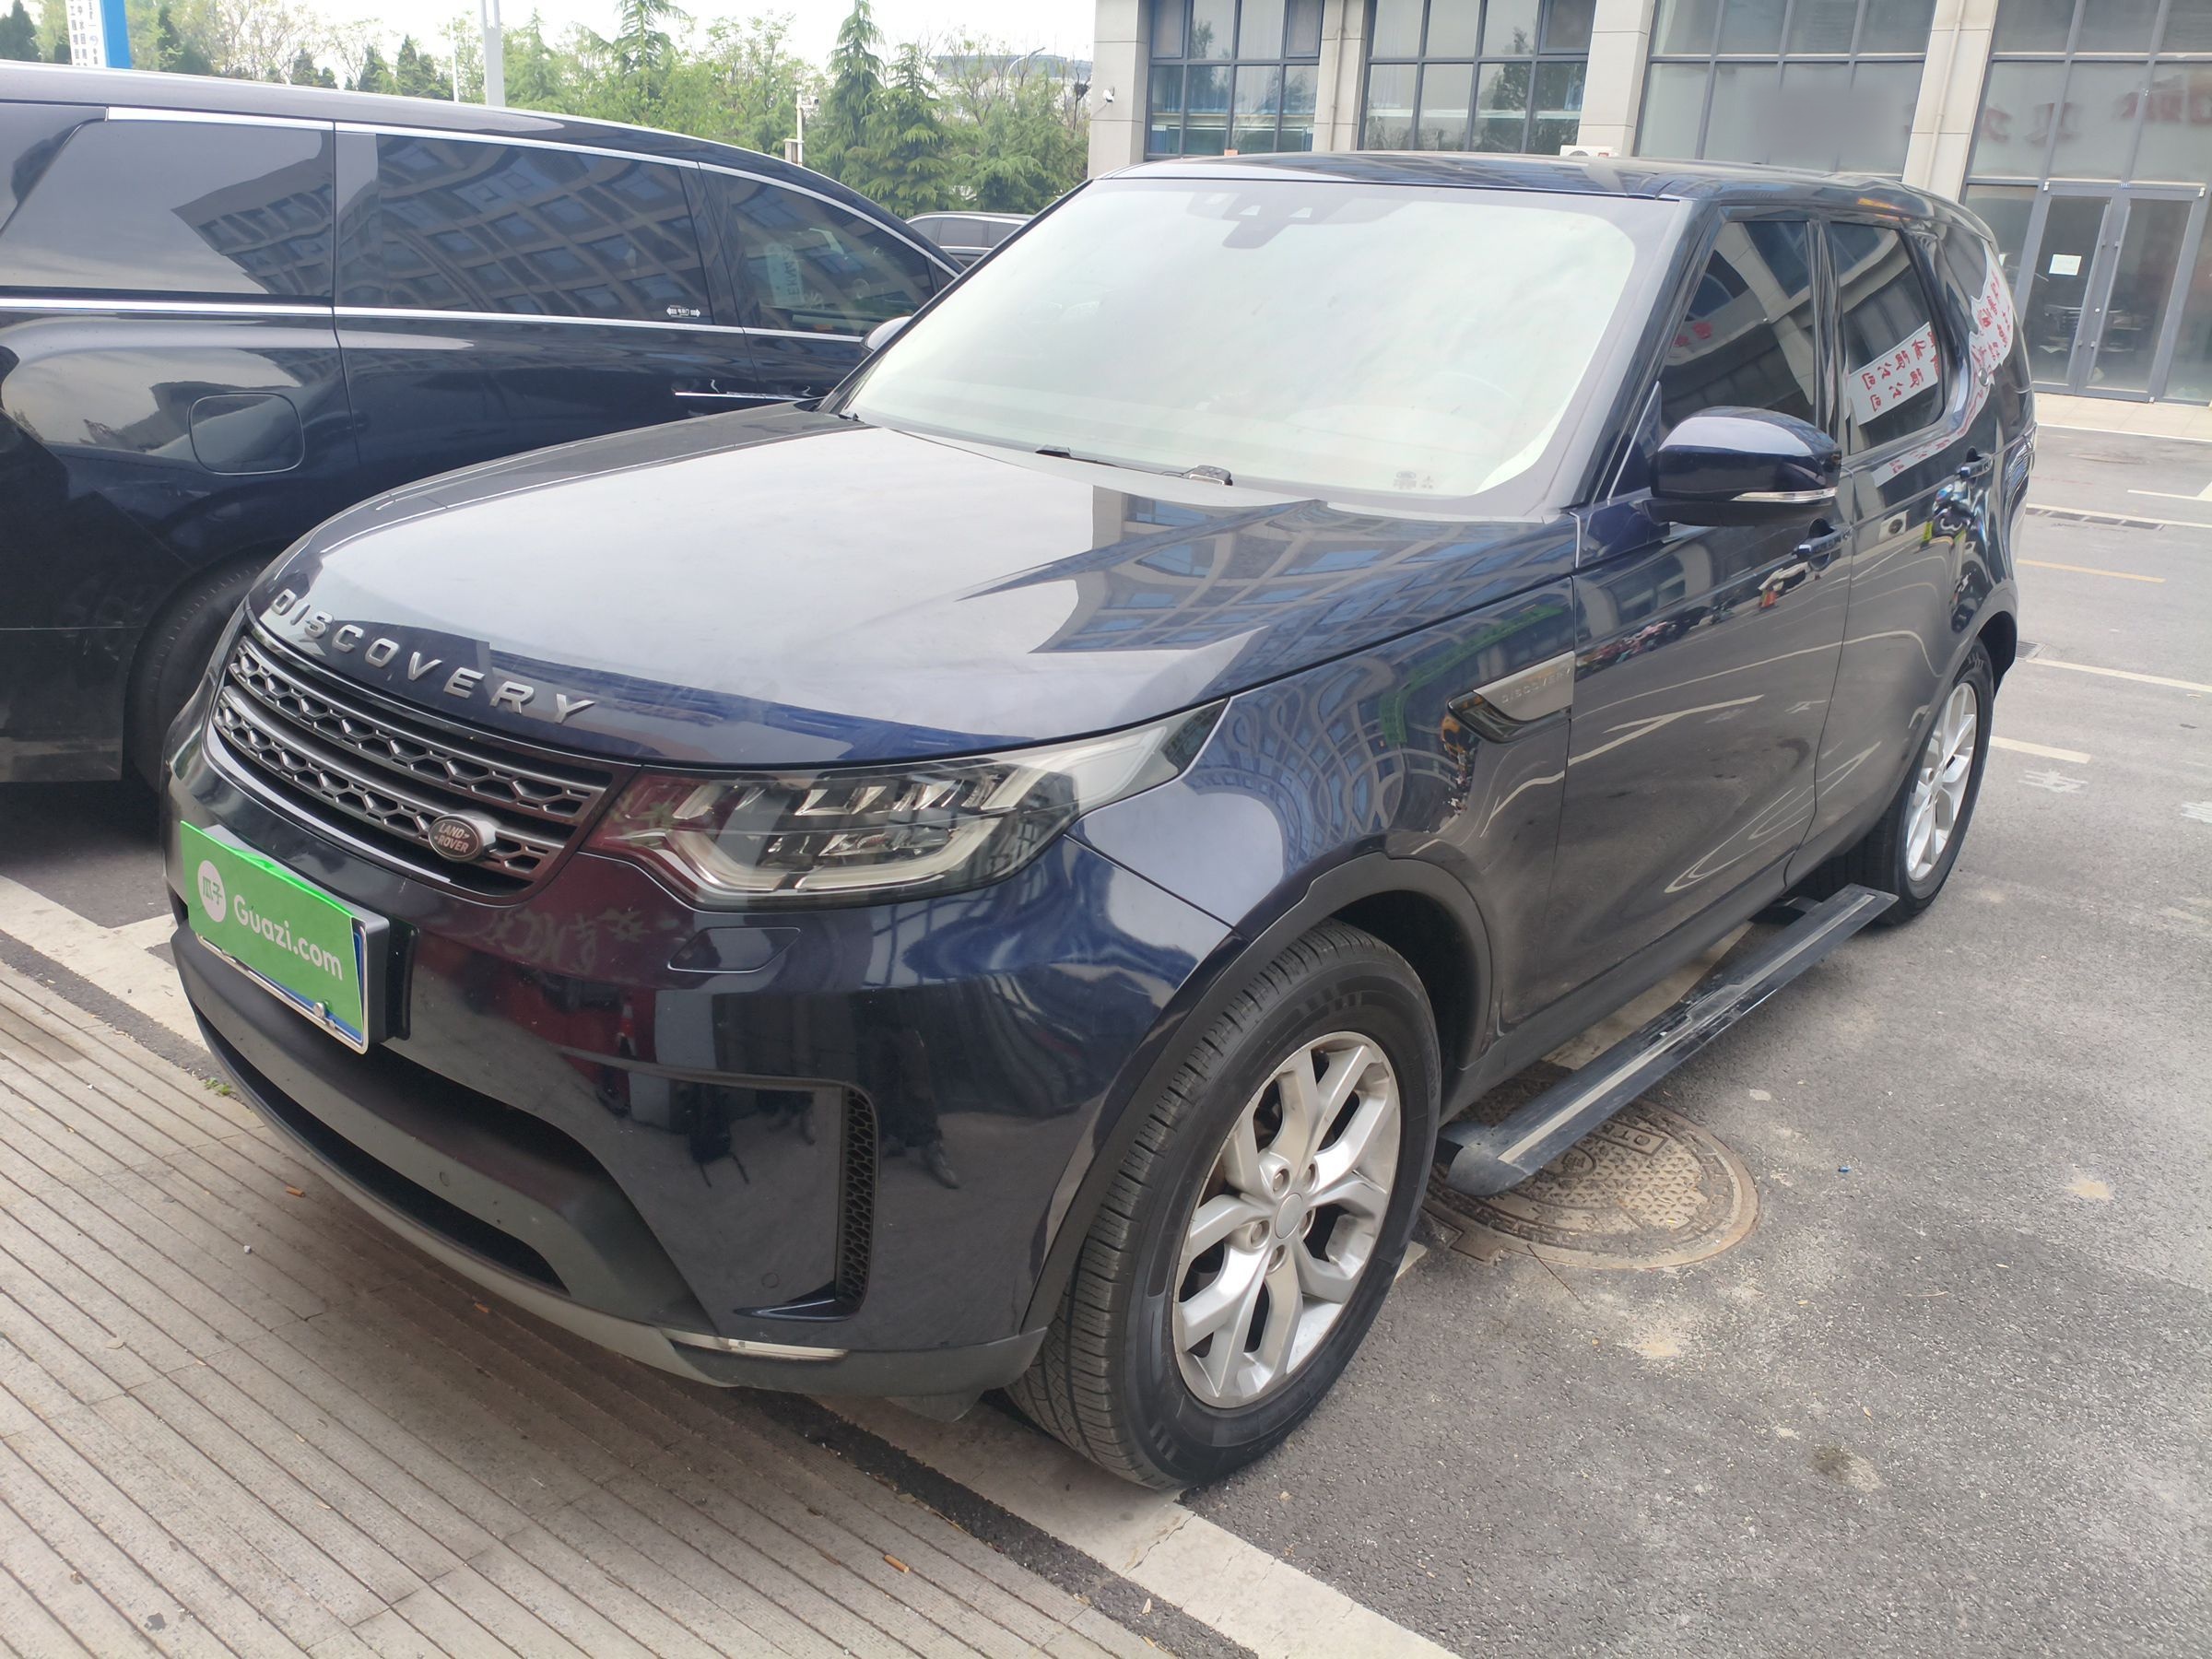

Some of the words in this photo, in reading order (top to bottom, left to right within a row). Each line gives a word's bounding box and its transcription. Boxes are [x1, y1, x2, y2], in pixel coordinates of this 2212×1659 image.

[270, 588, 595, 724] DISCOVERY
[438, 834, 469, 853] ROVER
[439, 822, 465, 840] LAND
[202, 876, 224, 906] 瓜子
[233, 894, 343, 981] Guazi.com
